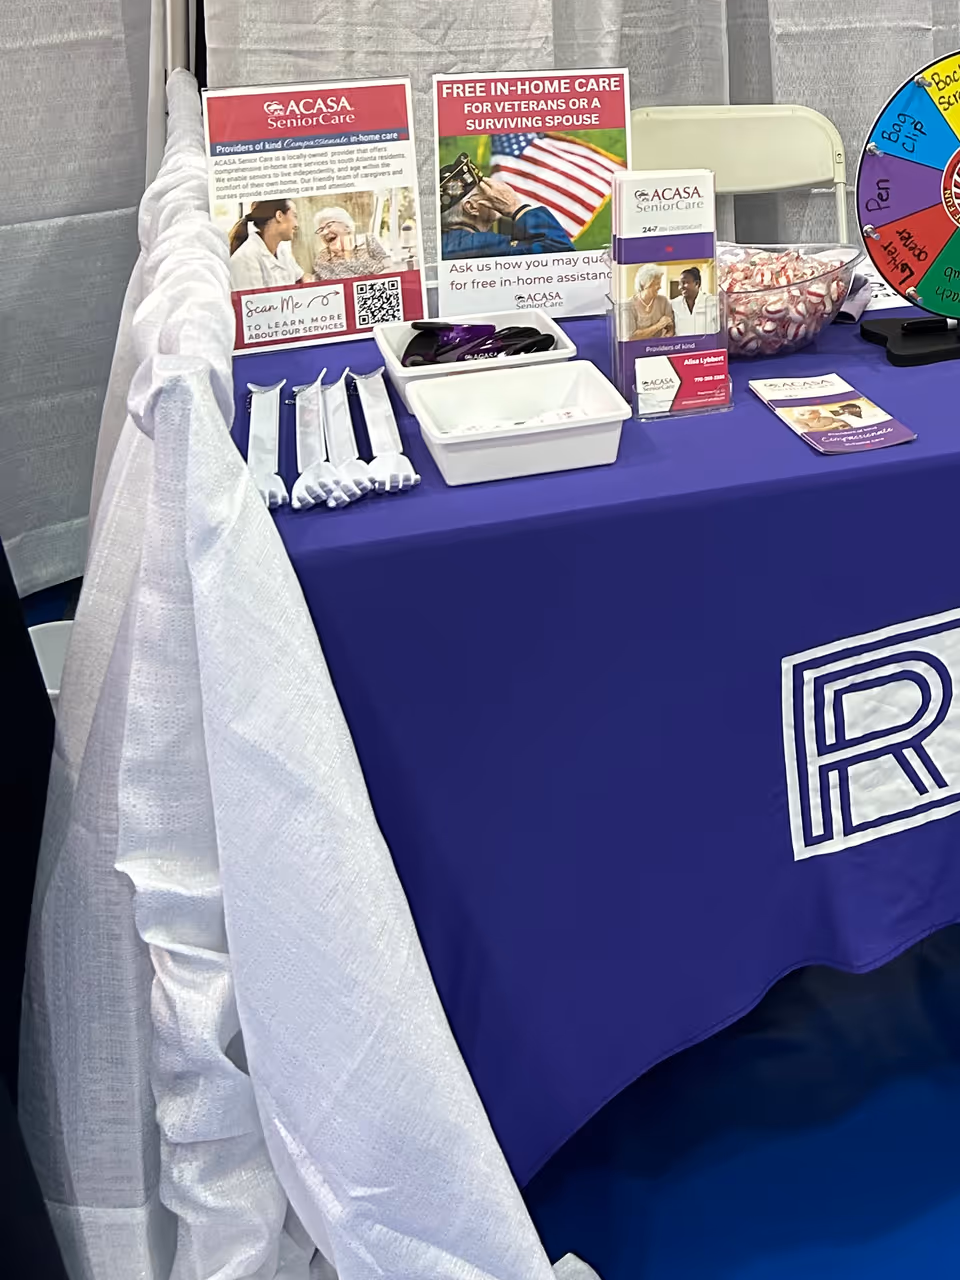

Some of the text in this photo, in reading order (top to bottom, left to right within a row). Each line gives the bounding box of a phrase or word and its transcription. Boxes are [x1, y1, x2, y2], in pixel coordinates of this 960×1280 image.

[441, 77, 621, 98] FREE IN-HOME CARE
[464, 97, 601, 114] FOR VETERANS OR A
[267, 113, 356, 129] SeniorCare
[466, 113, 600, 131] SURVIVING SPOUSE
[881, 112, 907, 143] Bag
[216, 143, 253, 154] Providers
[254, 141, 264, 151] of
[265, 140, 282, 150] kind
[350, 133, 380, 142] in-home
[381, 131, 398, 140] care
[865, 178, 890, 213] Pen
[944, 189, 956, 212] FUN
[635, 200, 704, 214] SeniorCare
[449, 262, 473, 274] Ask
[475, 263, 492, 272] us
[494, 259, 523, 271] how
[525, 259, 549, 272] you
[552, 257, 579, 270] may
[450, 280, 468, 291] for
[471, 278, 497, 290] free
[499, 274, 555, 289] in-home
[245, 295, 303, 319] Scan Me
[516, 301, 564, 310] SeniorCare
[247, 313, 343, 332] TO LEARN MORE
[247, 321, 345, 341] ABOUT OUR SERVICES
